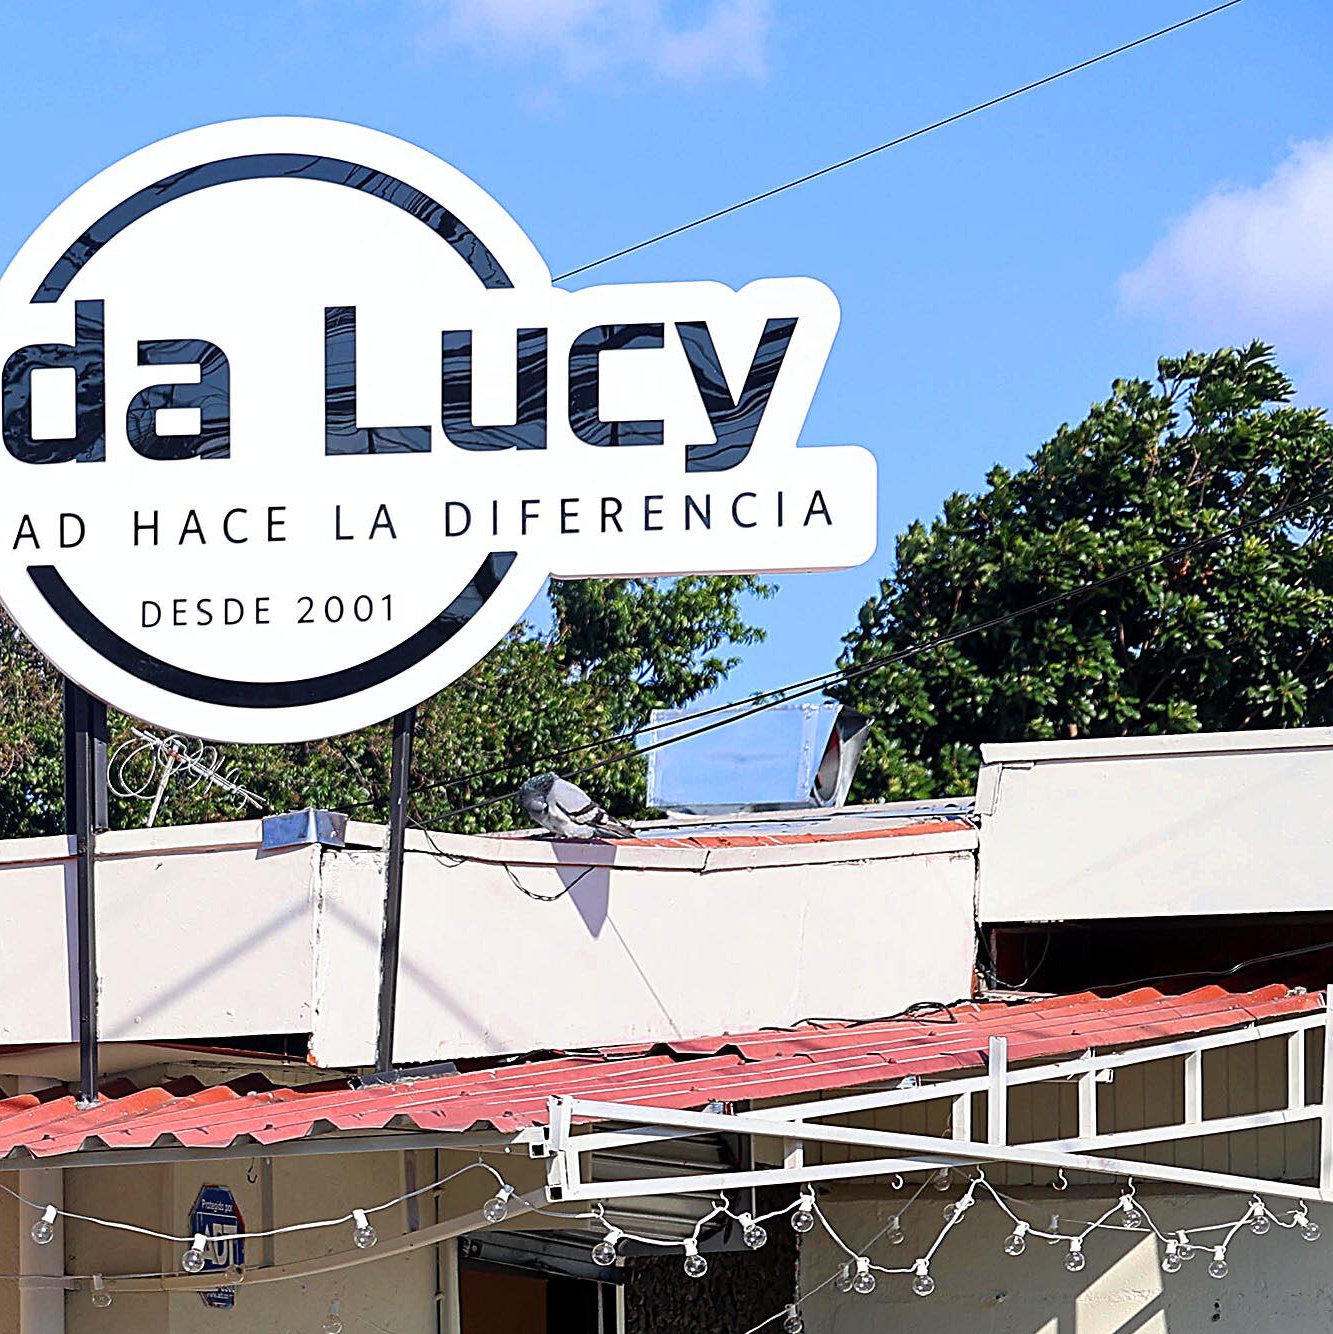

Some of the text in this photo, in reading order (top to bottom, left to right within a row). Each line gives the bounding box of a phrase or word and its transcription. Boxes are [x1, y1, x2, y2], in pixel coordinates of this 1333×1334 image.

[323, 304, 800, 474] Lucy
[132, 504, 288, 548] HACE
[334, 501, 399, 542] LA
[443, 488, 835, 539] DIFERENCIA
[140, 592, 397, 630] DESDE 2001
